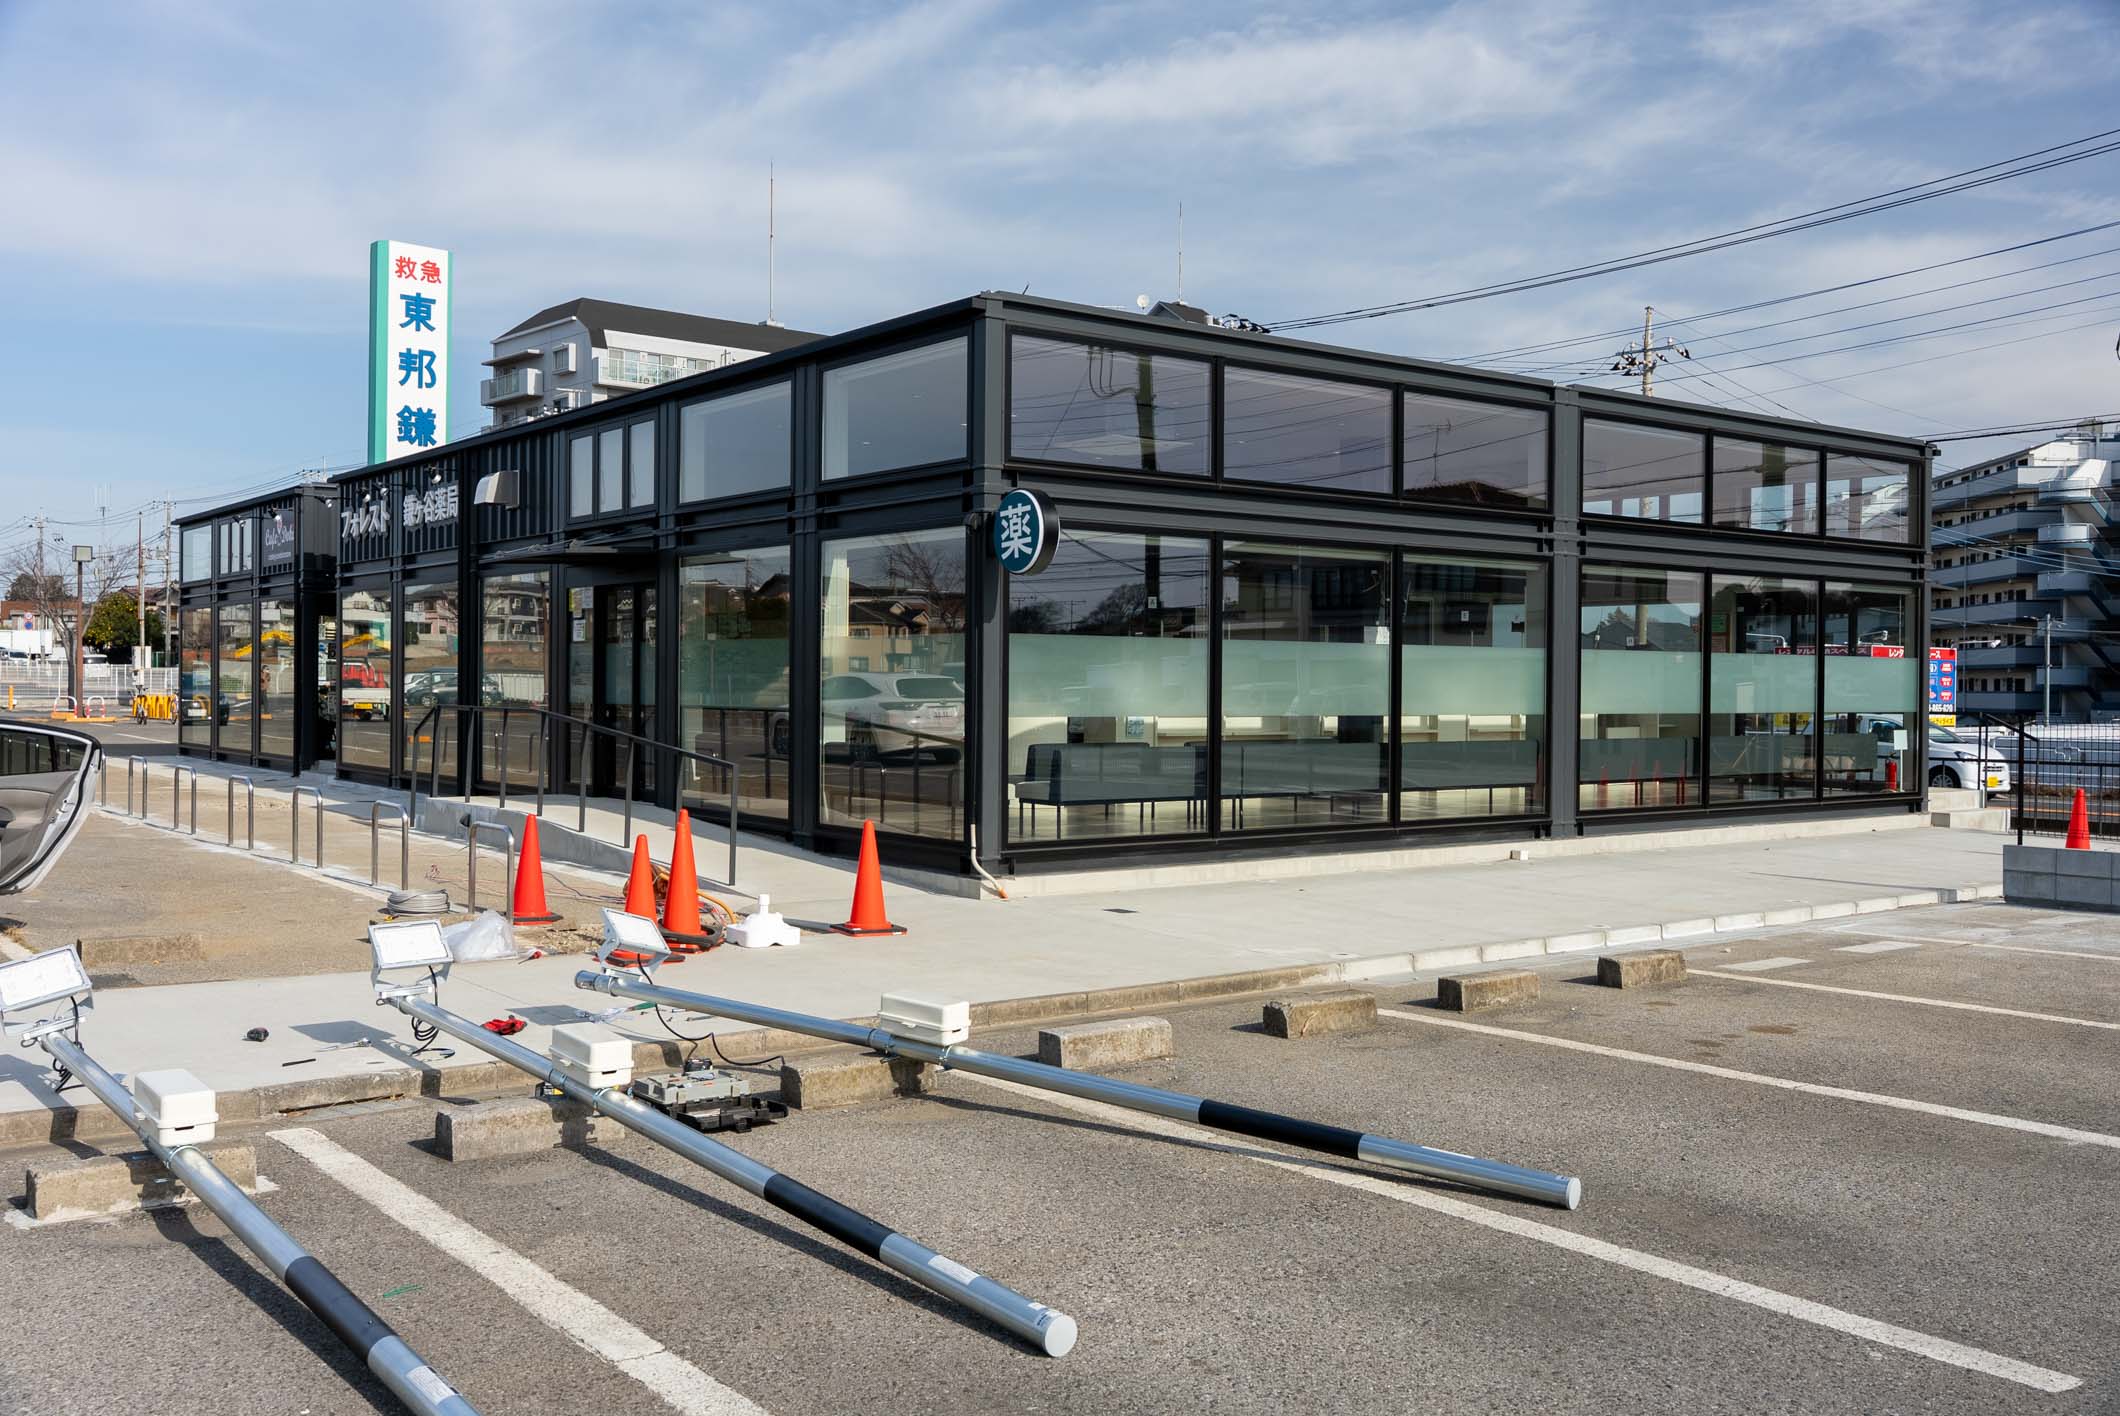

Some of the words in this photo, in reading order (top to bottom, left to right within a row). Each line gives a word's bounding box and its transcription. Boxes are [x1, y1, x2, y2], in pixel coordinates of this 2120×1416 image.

[394, 255, 442, 285] 救急
[396, 291, 438, 447] 東邦鎌
[340, 500, 391, 538] フォレスト
[1000, 503, 1032, 560] 薬
